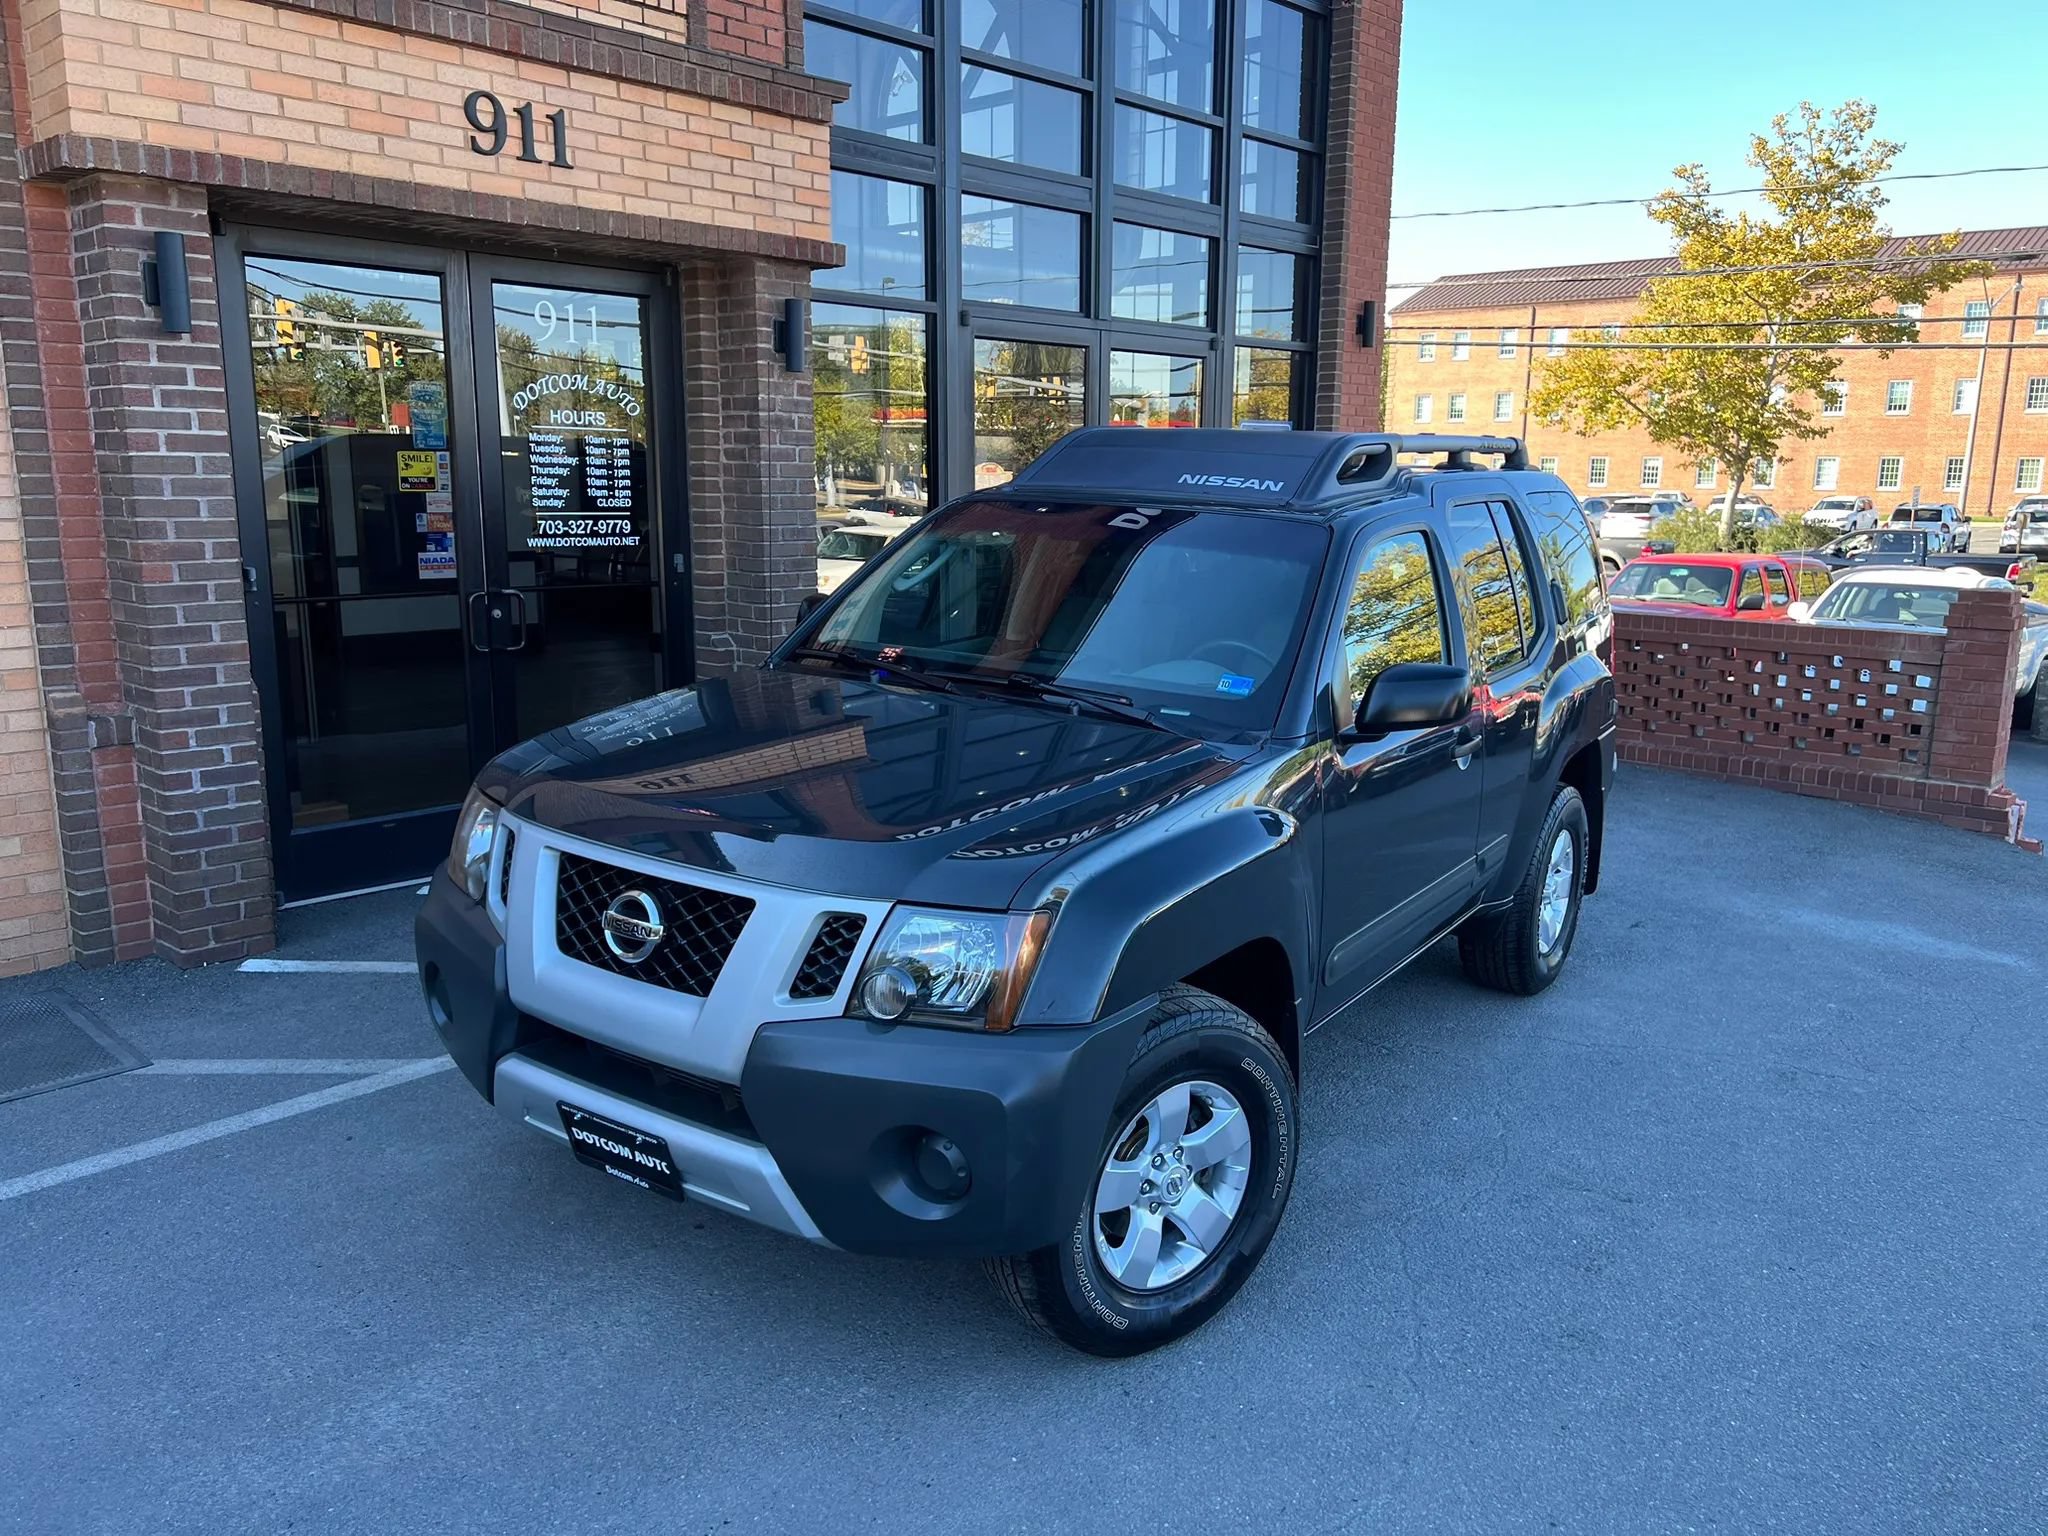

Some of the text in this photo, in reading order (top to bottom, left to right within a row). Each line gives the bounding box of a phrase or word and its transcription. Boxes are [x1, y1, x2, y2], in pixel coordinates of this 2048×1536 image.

[464, 90, 574, 169] 911
[534, 300, 601, 344] 911
[513, 374, 640, 416] DOTCOM AUTO
[550, 409, 606, 425] HOURS
[529, 433, 563, 444] Monday:
[584, 435, 606, 444] 10am
[529, 443, 566, 454] Tuesday:
[585, 446, 606, 454] 10am
[401, 454, 433, 463] SMILE!
[530, 454, 579, 466] Wednesday:
[585, 456, 607, 465] 10am
[530, 465, 570, 476] Thursday:
[586, 467, 607, 475] 10am
[531, 476, 559, 487] Friday:
[586, 478, 608, 486] 10am
[1178, 473, 1284, 492] NISSAN
[532, 487, 570, 497] Saturday:
[587, 488, 608, 496] 10am
[532, 498, 632, 508] Sunday: CLOSED
[537, 520, 631, 534] 703-327-9779
[527, 536, 640, 547] WWW.DOTCOMAUTO.NET
[420, 557, 455, 565] NIADA
[1220, 680, 1230, 688] 10
[607, 915, 652, 938] NISSAN
[1241, 1057, 1288, 1200] CONTINENTAL
[571, 1127, 633, 1160] DOTCOM
[1072, 1202, 1129, 1331] CONTINENT
